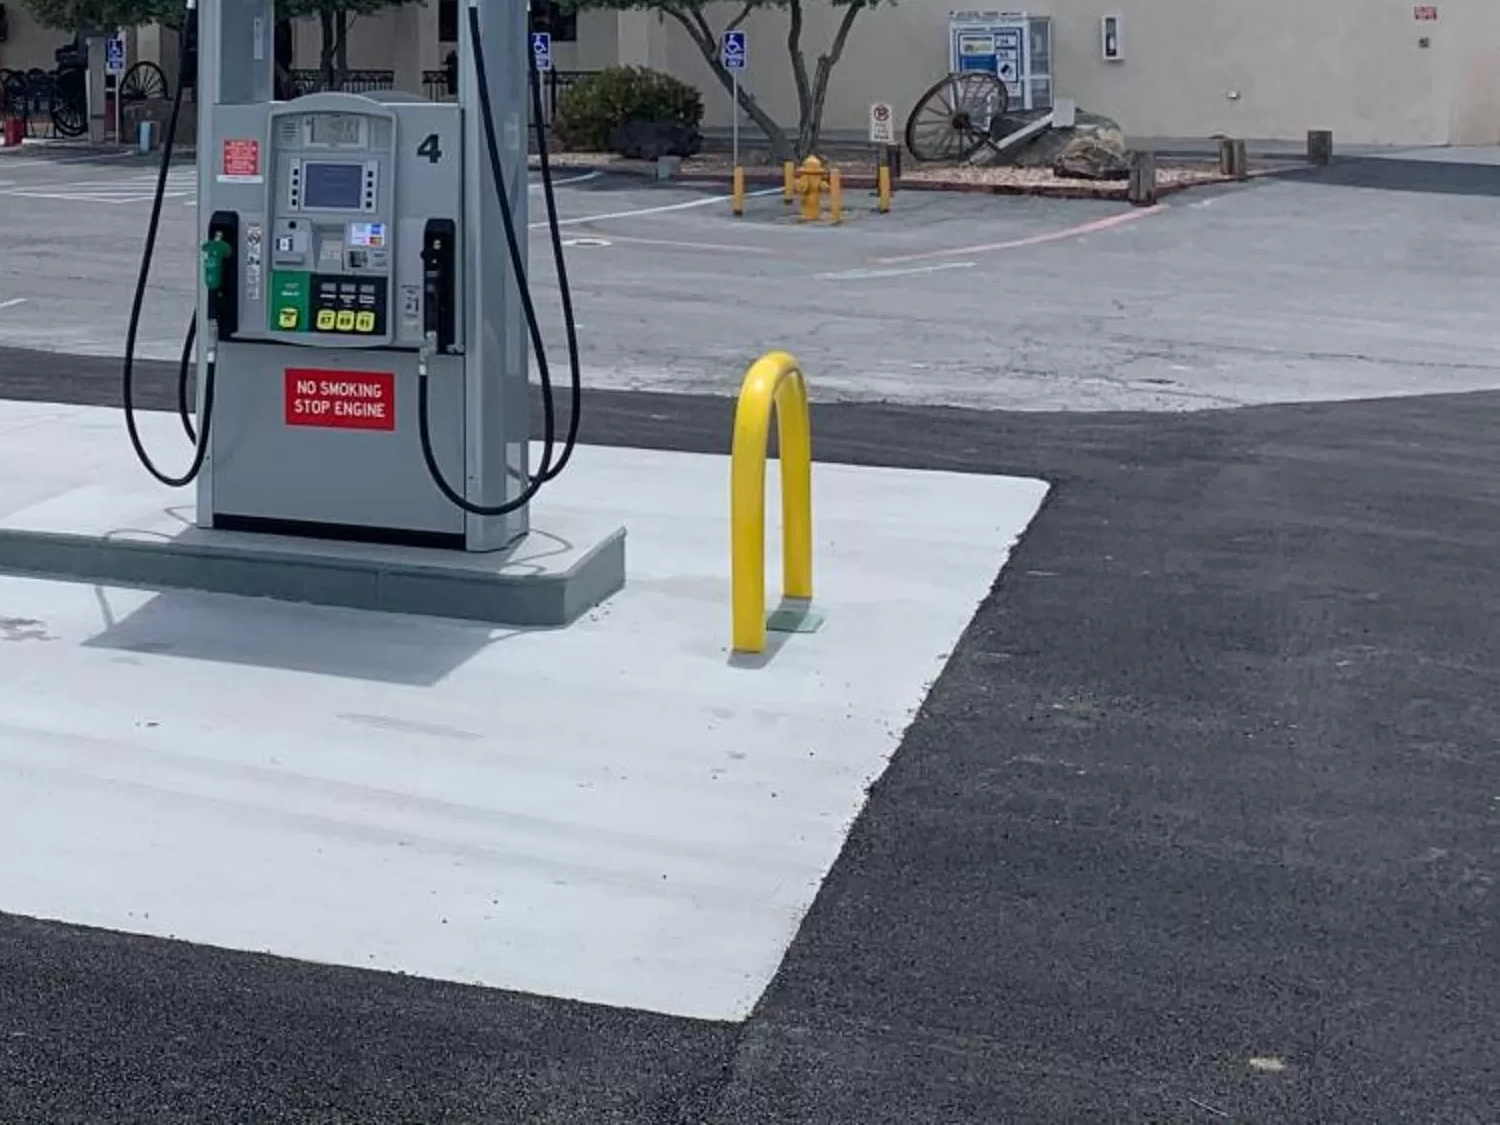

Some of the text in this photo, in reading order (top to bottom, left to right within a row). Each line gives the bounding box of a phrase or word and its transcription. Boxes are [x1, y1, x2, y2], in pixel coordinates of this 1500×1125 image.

[417, 134, 442, 163] 4
[297, 381, 382, 397] NO SMOKING
[295, 399, 385, 417] STOP ENGINE
